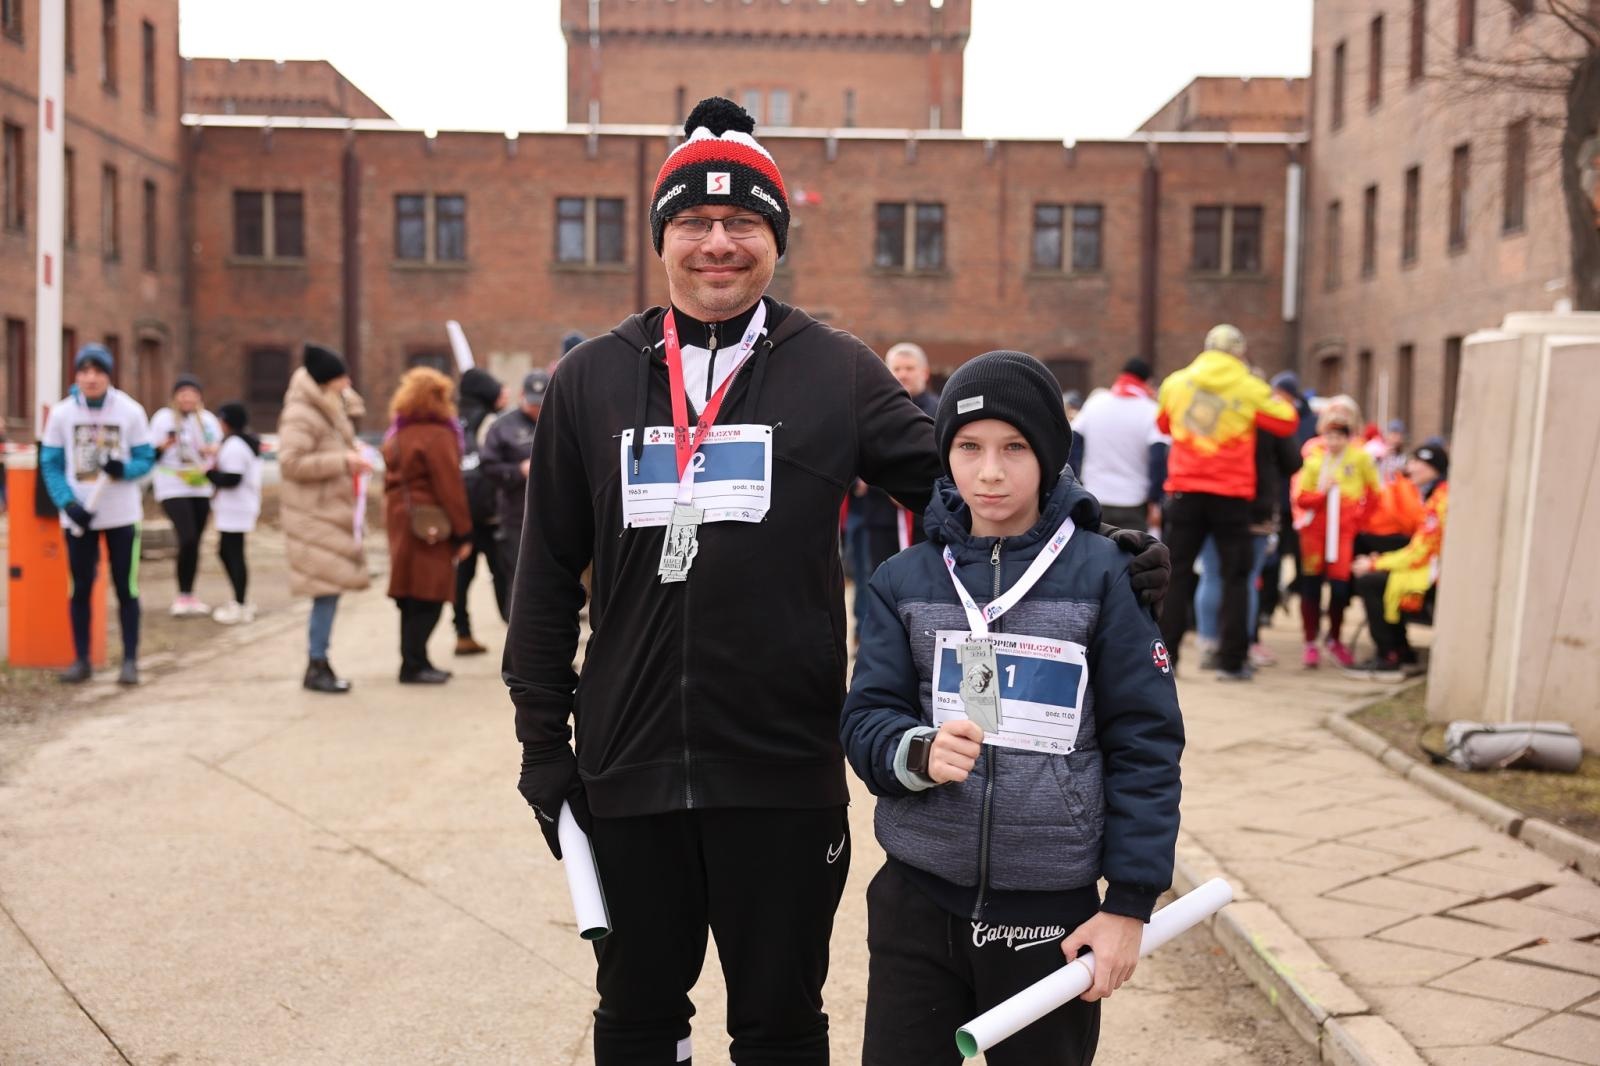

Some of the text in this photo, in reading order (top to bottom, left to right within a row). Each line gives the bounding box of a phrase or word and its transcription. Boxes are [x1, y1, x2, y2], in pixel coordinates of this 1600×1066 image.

[693, 451, 706, 473] 2
[1019, 642, 1062, 655] WILCZYM
[1005, 664, 1016, 688] 1
[937, 696, 951, 704] 1963
